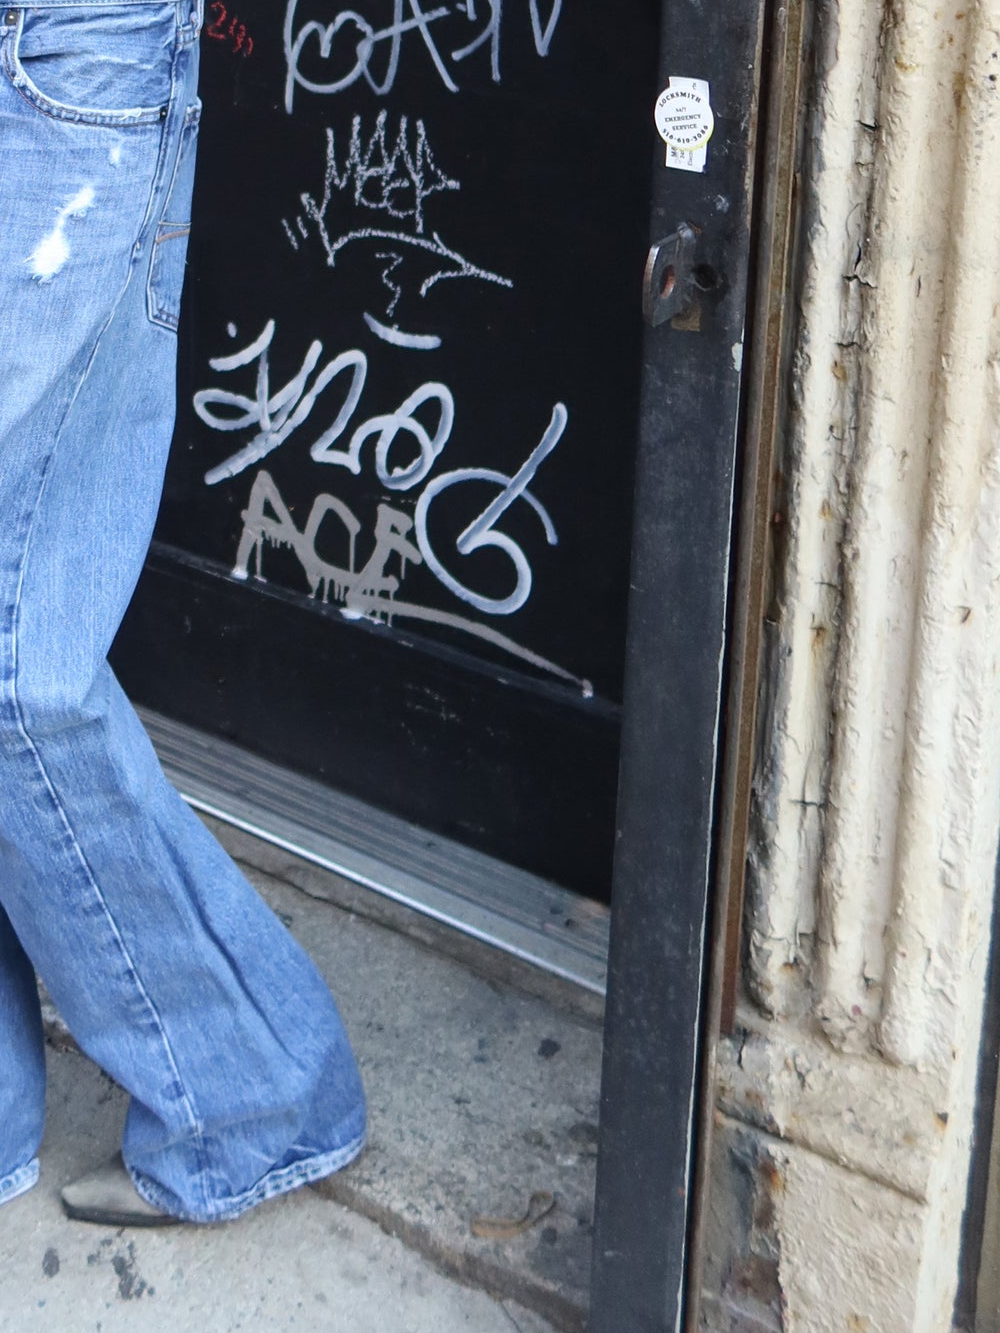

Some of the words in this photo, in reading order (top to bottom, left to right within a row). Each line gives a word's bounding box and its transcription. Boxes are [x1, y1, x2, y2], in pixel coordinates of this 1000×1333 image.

[658, 91, 702, 108] LOCKSMITH
[664, 114, 702, 123] EMERGENCY
[671, 123, 698, 131] SERVICE
